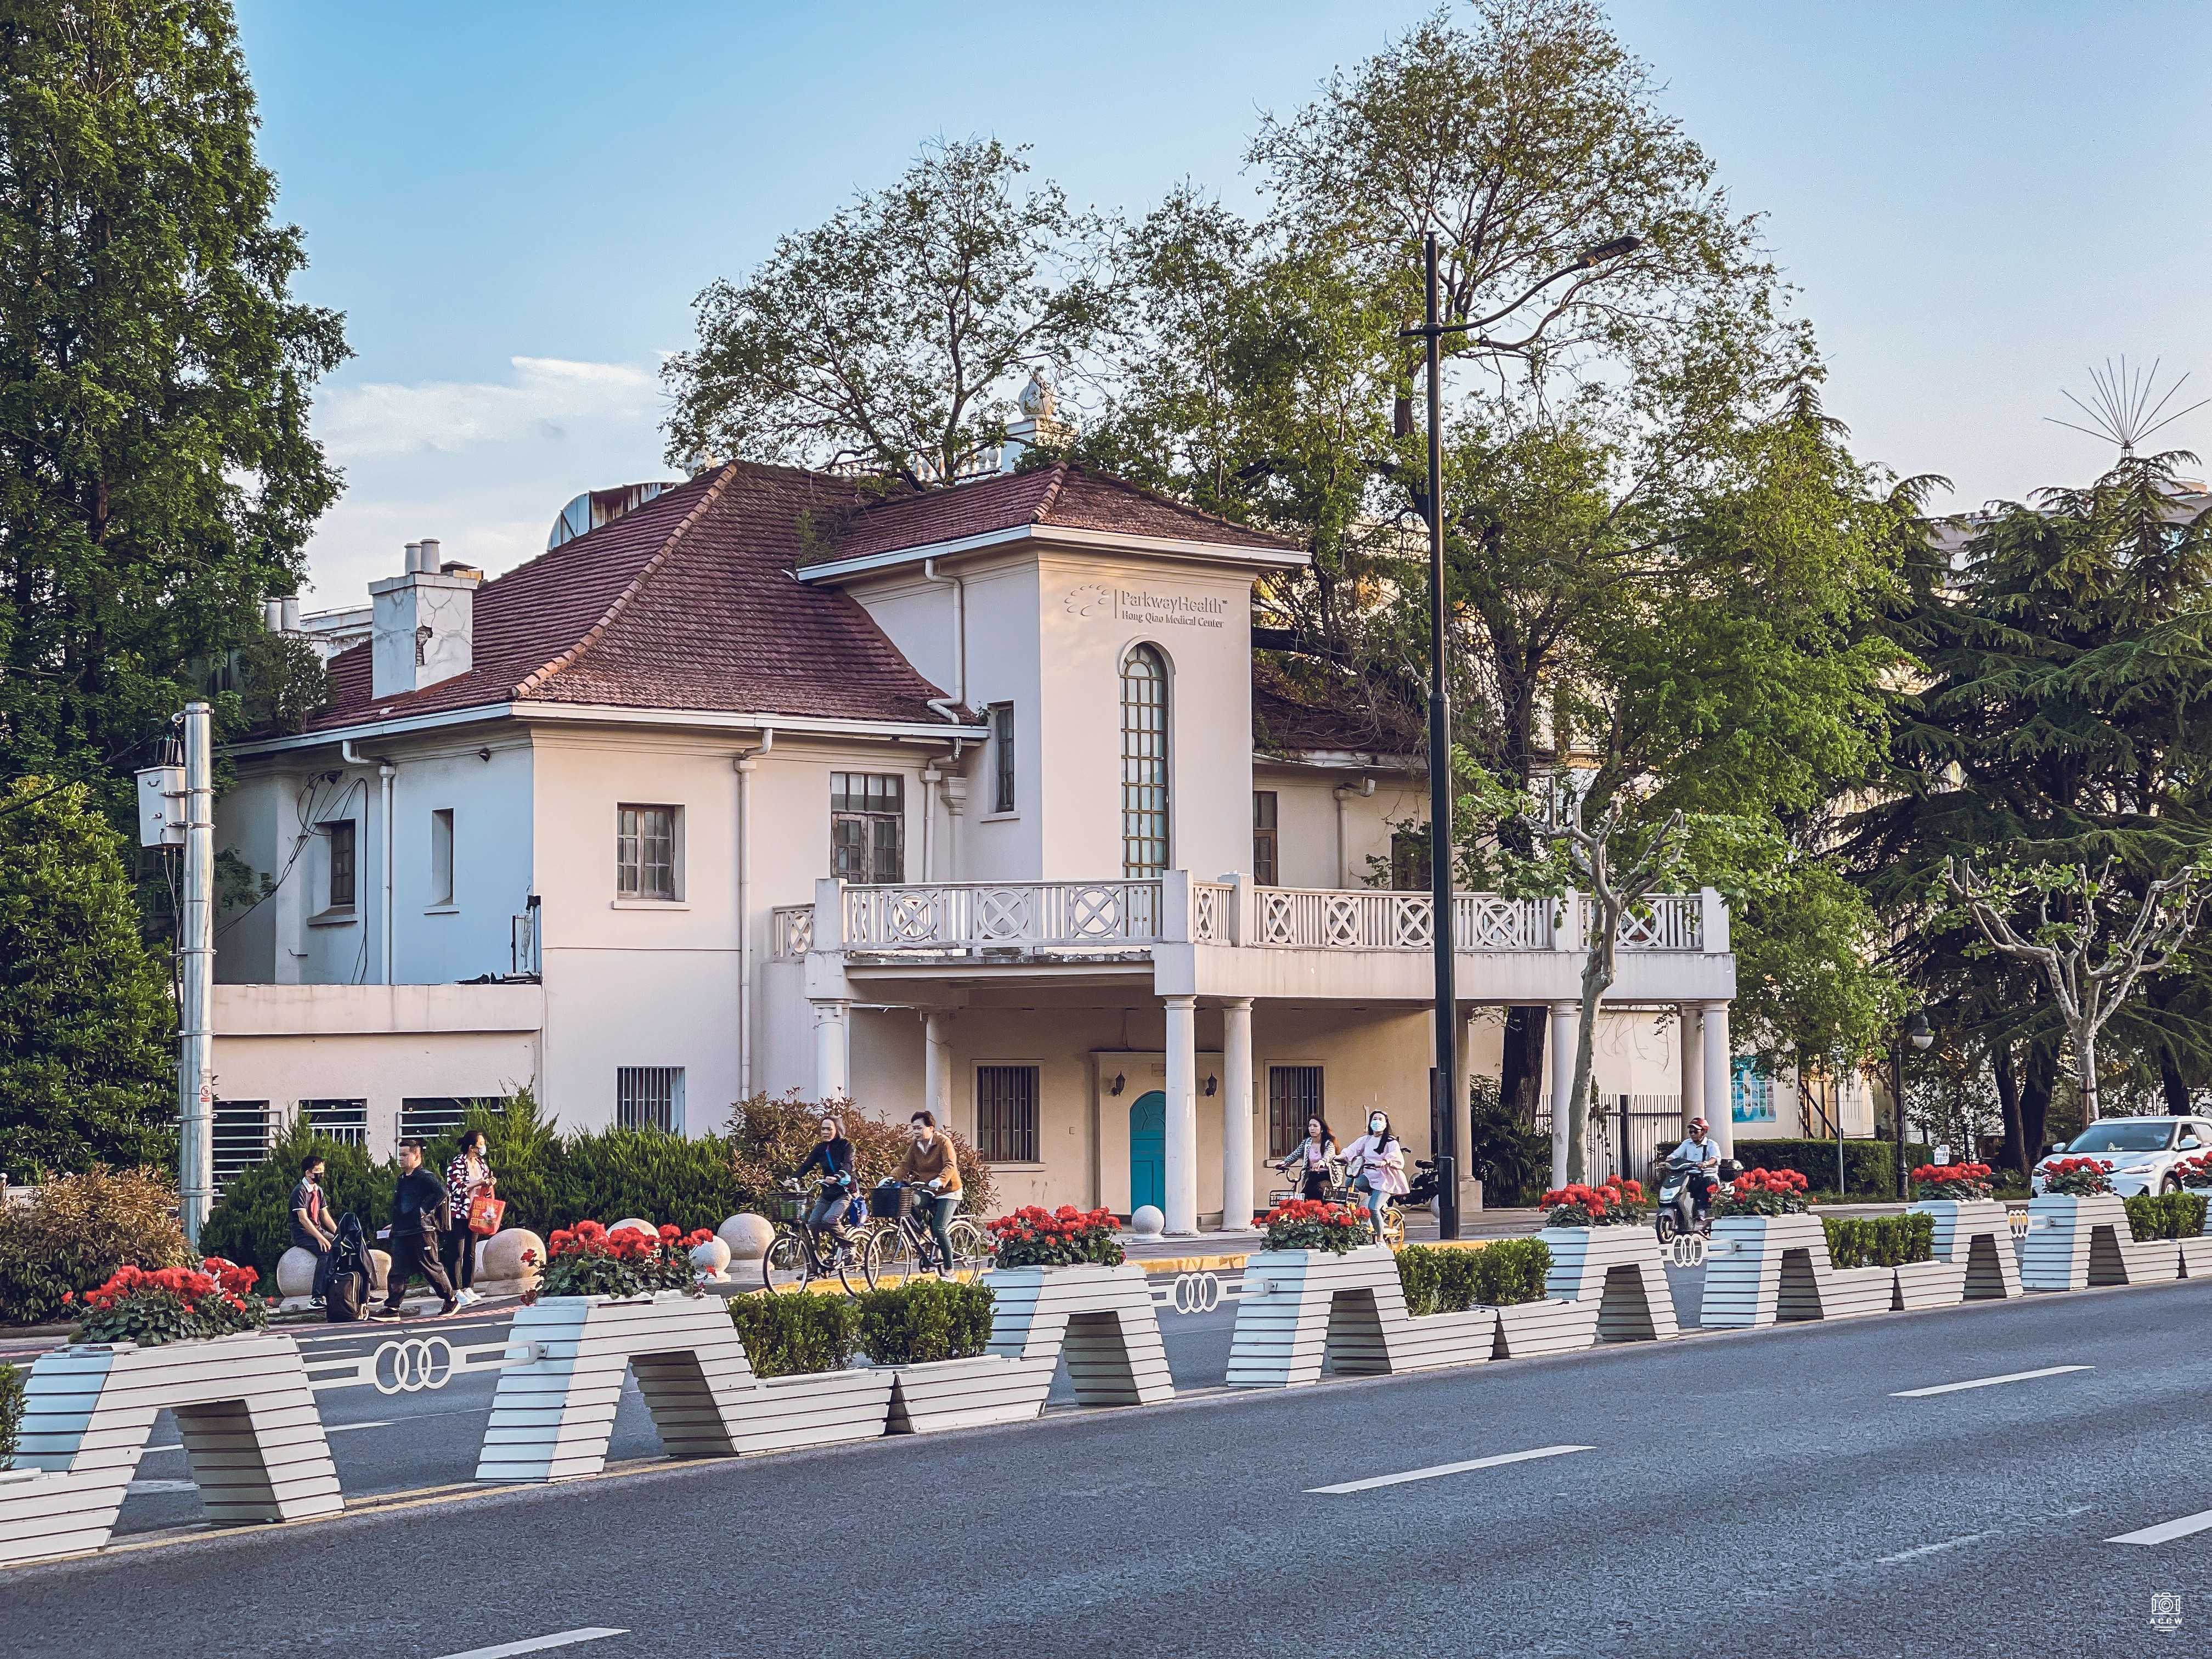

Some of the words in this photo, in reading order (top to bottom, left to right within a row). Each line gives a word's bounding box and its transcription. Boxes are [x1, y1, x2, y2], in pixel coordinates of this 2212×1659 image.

[1122, 610, 1143, 623] Hong
[1145, 612, 1164, 624] Qiao
[1166, 614, 1196, 626] Medical
[1198, 617, 1224, 628] Center
